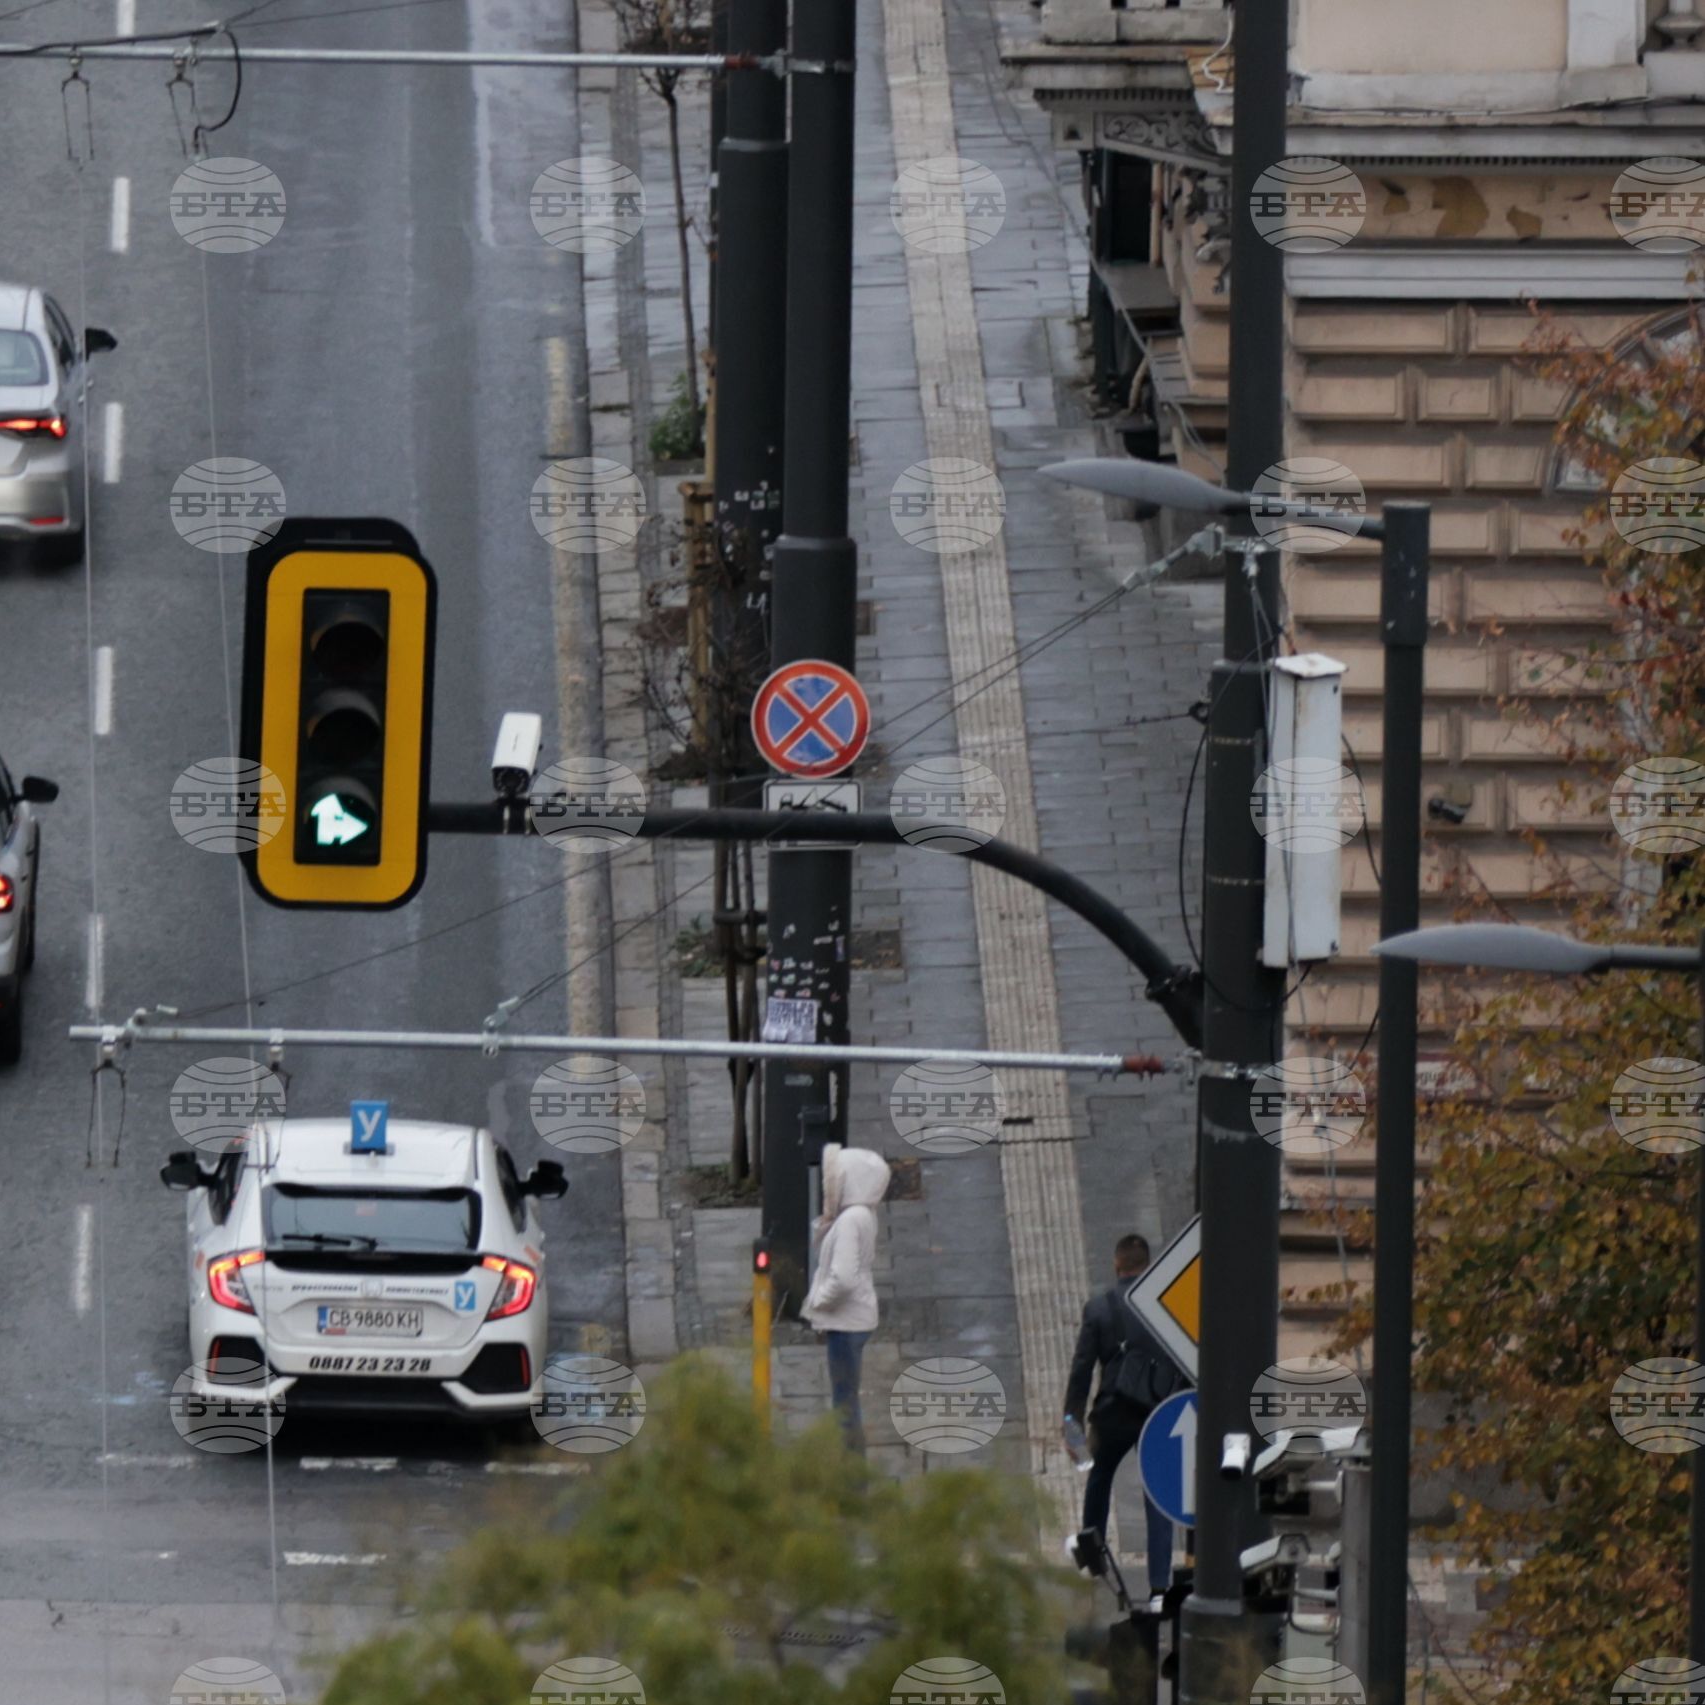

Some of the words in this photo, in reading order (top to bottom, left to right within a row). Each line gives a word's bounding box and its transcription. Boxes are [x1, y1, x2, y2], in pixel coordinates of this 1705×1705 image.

[309, 1356, 354, 1370] 0887
[355, 1357, 378, 1371] 23
[381, 1358, 406, 1371] 23
[408, 1358, 432, 1372] 28
